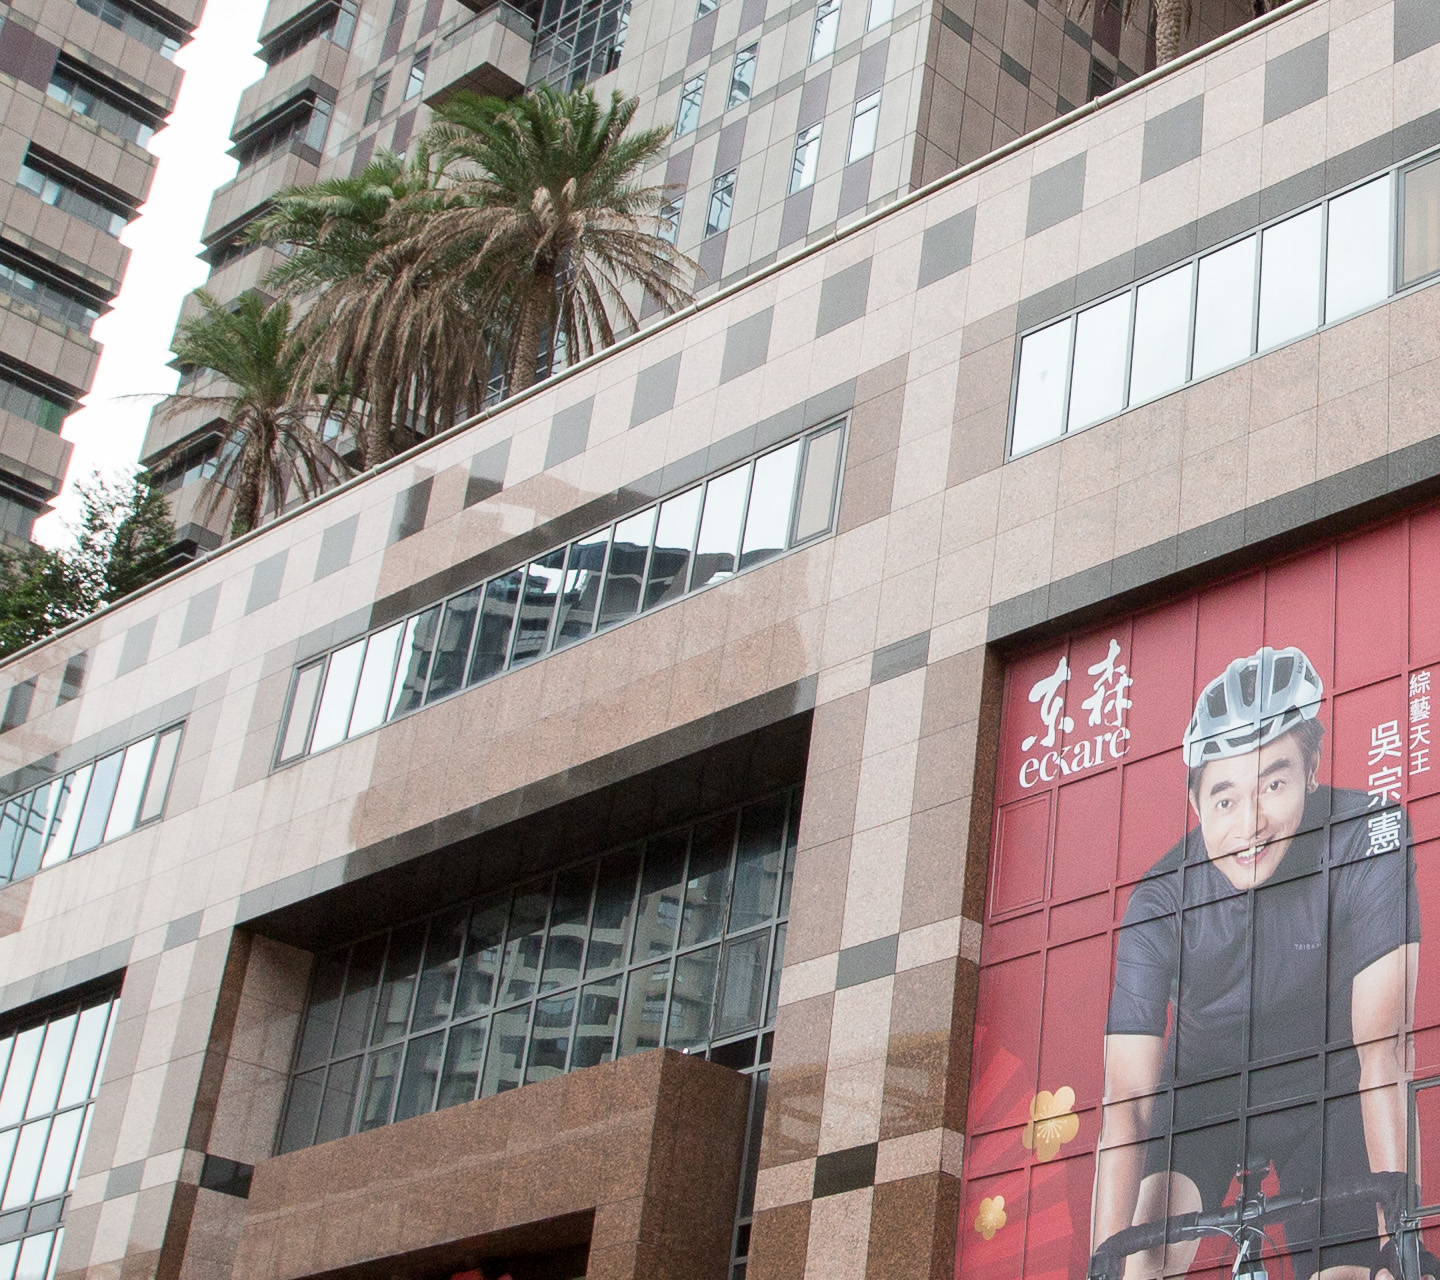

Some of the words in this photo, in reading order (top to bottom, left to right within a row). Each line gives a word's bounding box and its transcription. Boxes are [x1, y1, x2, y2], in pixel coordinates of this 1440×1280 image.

[1019, 727, 1131, 788] eckare
[1409, 671, 1431, 776] 綜藝天王
[1365, 720, 1403, 856] 吳宗憲
